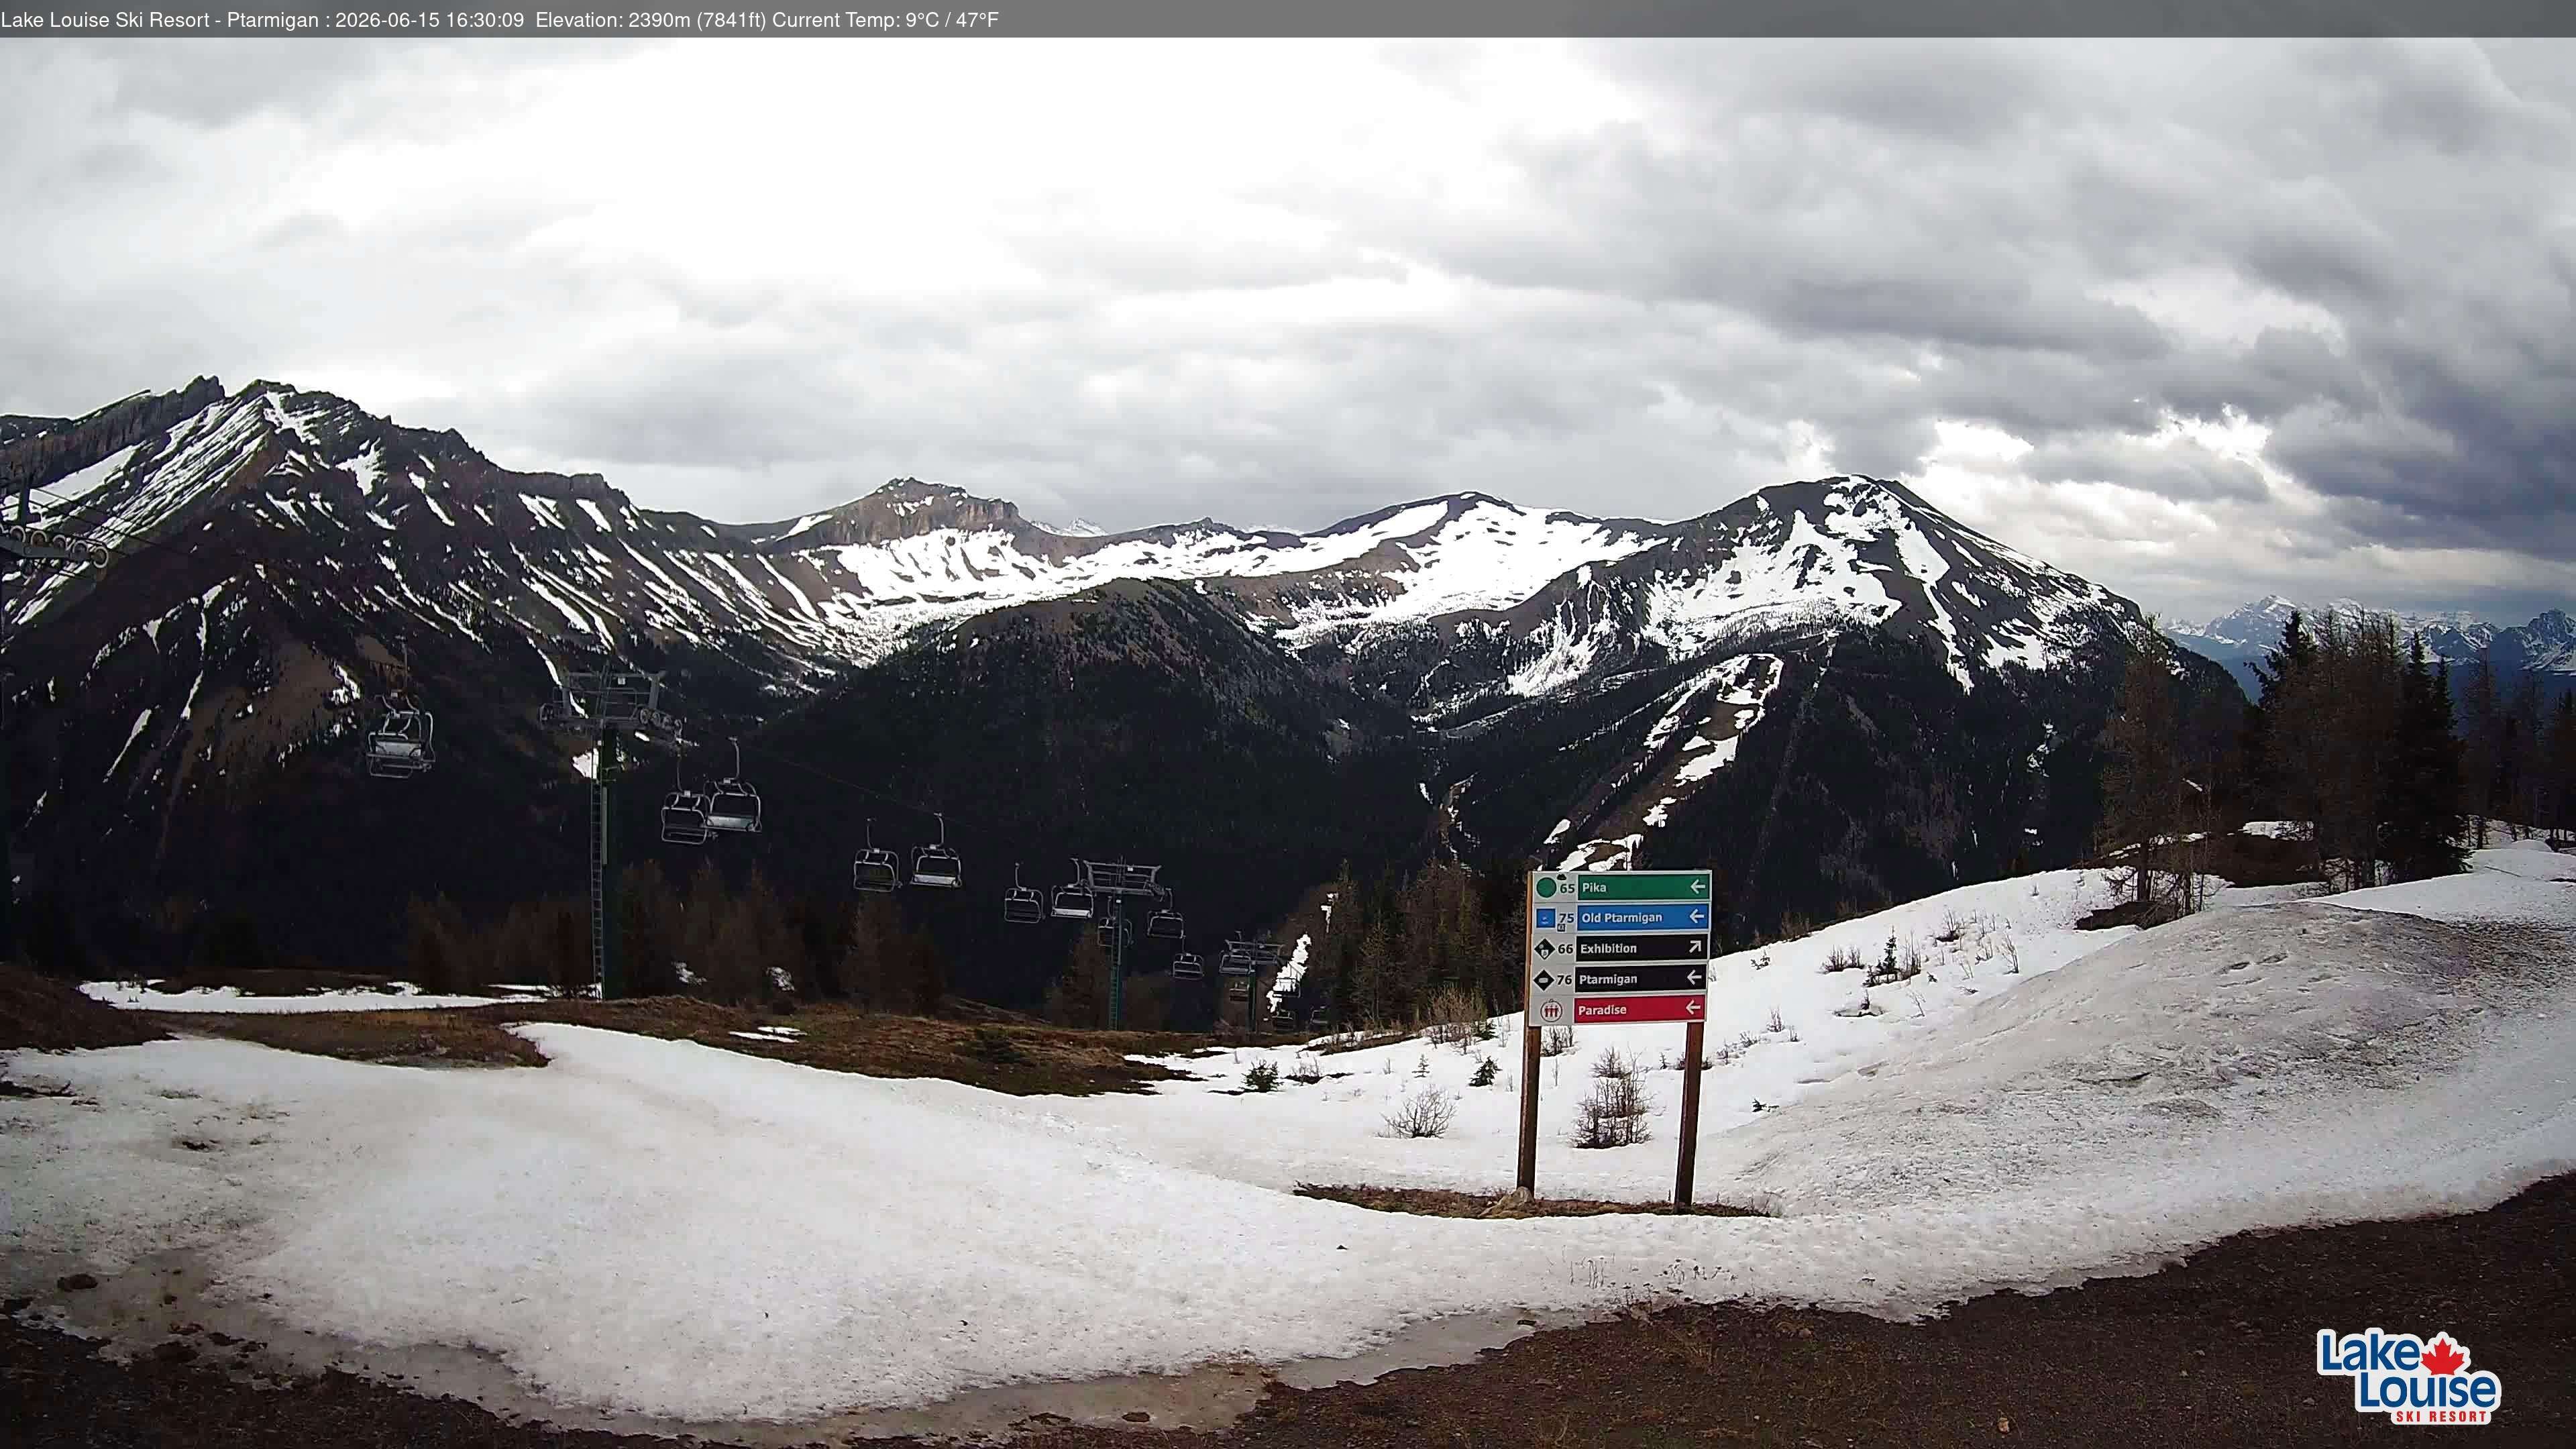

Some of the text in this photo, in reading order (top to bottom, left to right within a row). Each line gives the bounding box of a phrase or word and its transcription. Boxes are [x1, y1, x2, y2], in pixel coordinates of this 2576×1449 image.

[1560, 882, 1607, 894] 65 Pika
[1559, 912, 1663, 925] 75 Old Ptarmigan
[1558, 944, 1637, 955] 66 Exhibition
[1557, 974, 1638, 987] 76 Ptarmigan
[1578, 1005, 1627, 1016] Paradise
